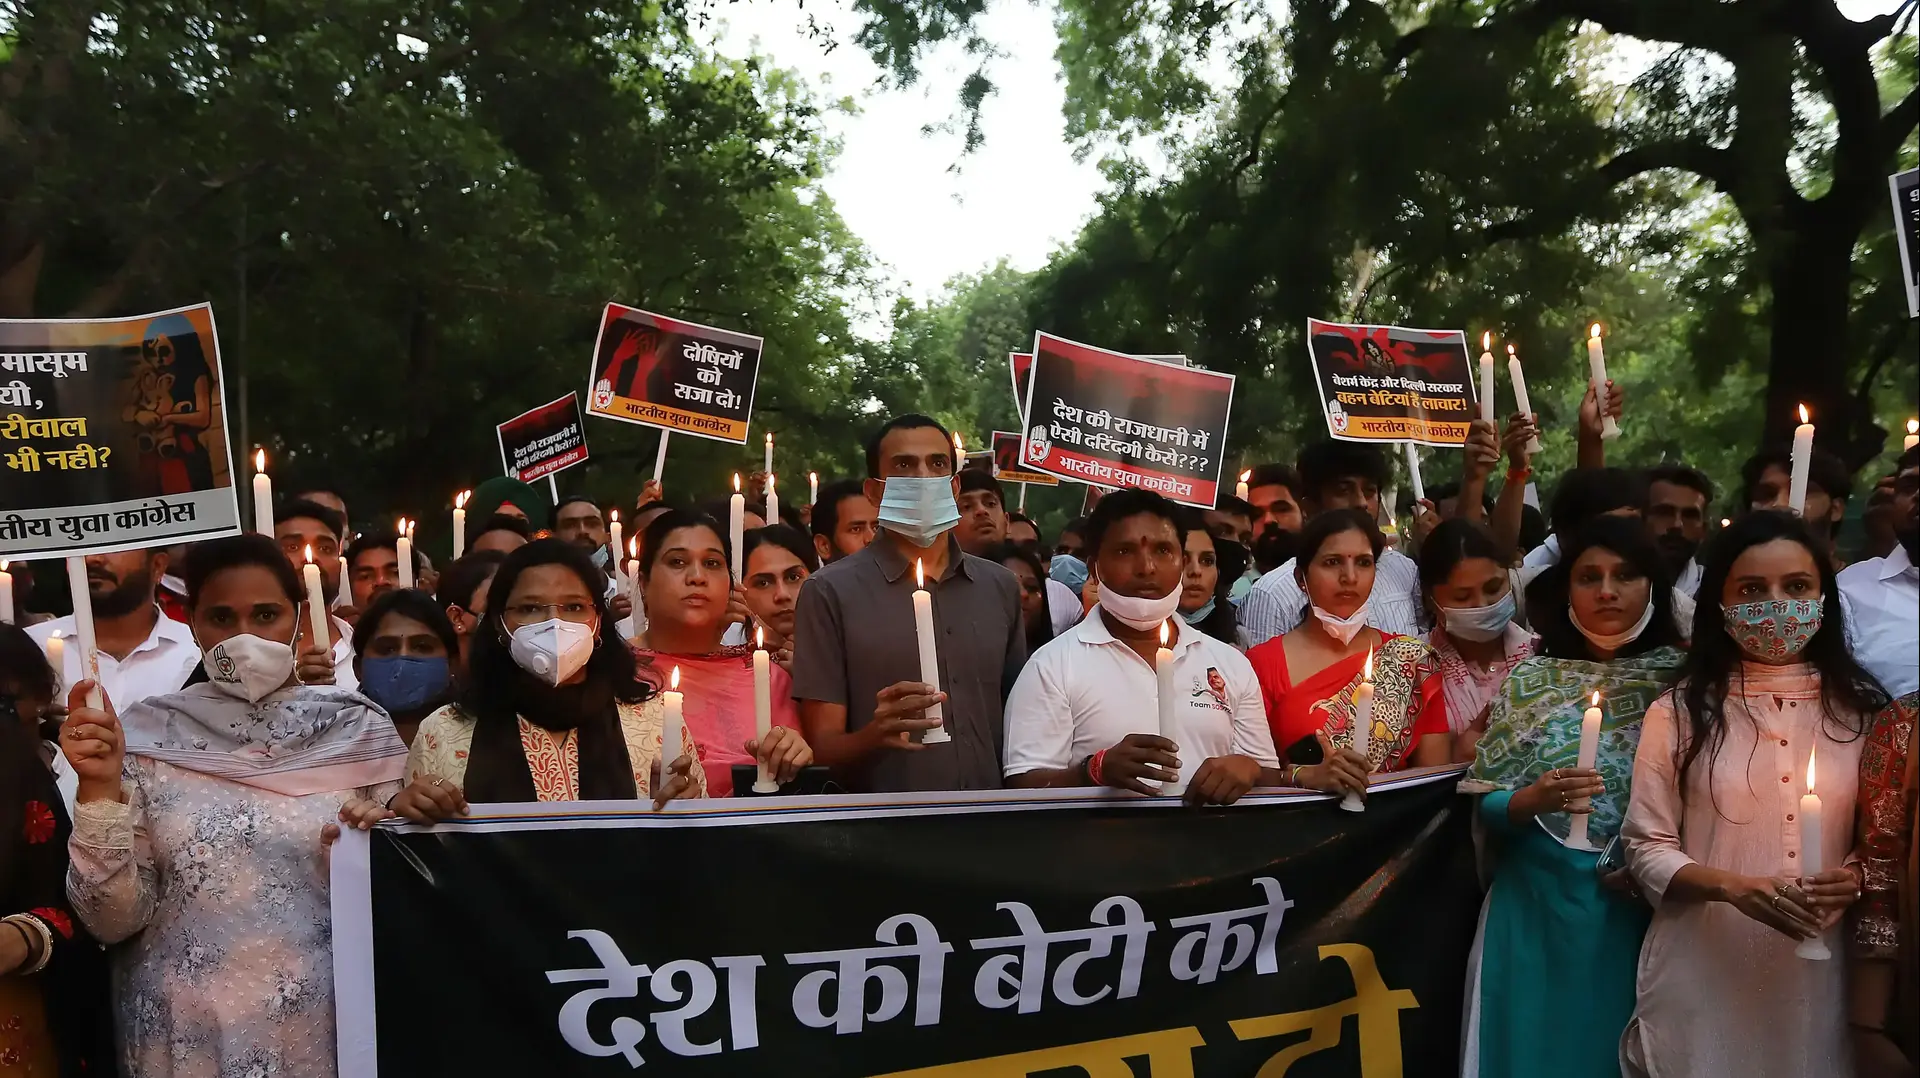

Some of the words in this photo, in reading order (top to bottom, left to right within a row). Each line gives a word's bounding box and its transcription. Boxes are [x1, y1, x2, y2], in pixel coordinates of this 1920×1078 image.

[0, 352, 88, 378] मासूम
[682, 341, 744, 370] दोषियों
[696, 366, 723, 386] को
[1332, 373, 1359, 387] बेशर्म
[1359, 375, 1379, 389] केंद्र
[1380, 376, 1401, 389] और
[1400, 376, 1427, 392] दिल्ली
[1426, 383, 1463, 393] सरकार
[674, 382, 714, 404] सजा
[715, 388, 742, 410] दो!
[1335, 391, 1368, 406] बहन
[1368, 389, 1410, 407] बेटियां
[1420, 396, 1468, 411] लाचार!
[625, 402, 668, 420] भारतीय
[669, 411, 691, 426] युवा
[693, 416, 731, 434] कांग्रेस
[1052, 397, 1084, 424] देश
[1085, 409, 1112, 431] की
[1114, 415, 1190, 448] राजधानी
[1191, 429, 1211, 451] में
[1361, 420, 1406, 433] भारतीय
[1428, 423, 1466, 438] कांग्रेस
[4, 446, 41, 472] भी
[43, 443, 112, 469] नही?
[1050, 420, 1083, 445] ऐसी
[1084, 432, 1143, 460] दरिंदगी
[1144, 442, 1209, 473] कैसे???
[1059, 455, 1113, 479] भारतीय
[1113, 468, 1141, 487] युवा
[1143, 475, 1193, 497] कांग्रेस
[55, 513, 110, 541] युवा
[113, 499, 196, 531] कांग्रेस
[545, 929, 767, 1070] देश
[783, 913, 955, 1035] की
[969, 895, 1157, 1015] बेटी
[1169, 876, 1295, 986] को
